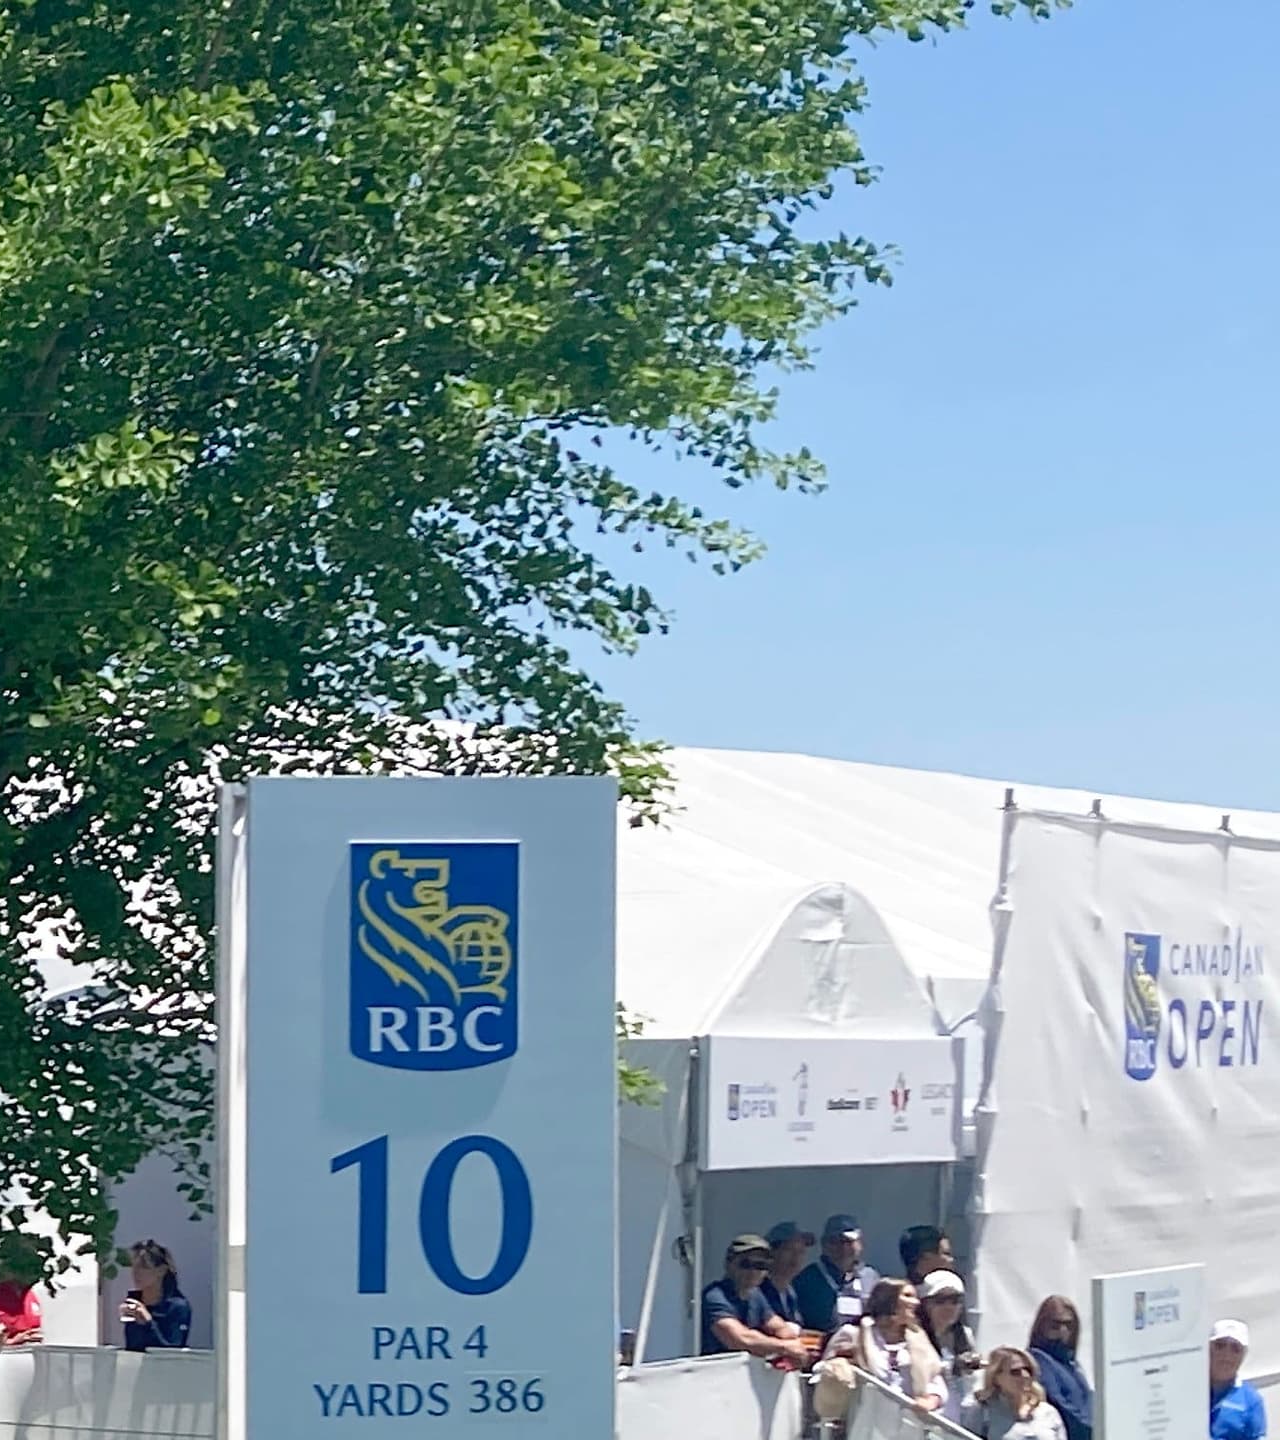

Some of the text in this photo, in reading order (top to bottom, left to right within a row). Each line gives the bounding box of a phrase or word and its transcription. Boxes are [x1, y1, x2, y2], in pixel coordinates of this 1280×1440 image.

[366, 1005, 505, 1053] RBC
[1167, 999, 1265, 1070] OPEN
[1127, 1038, 1156, 1070] RBC
[328, 1133, 534, 1296] 10
[372, 1324, 489, 1360] PAR 4
[314, 1378, 545, 1417] YARDS 386
